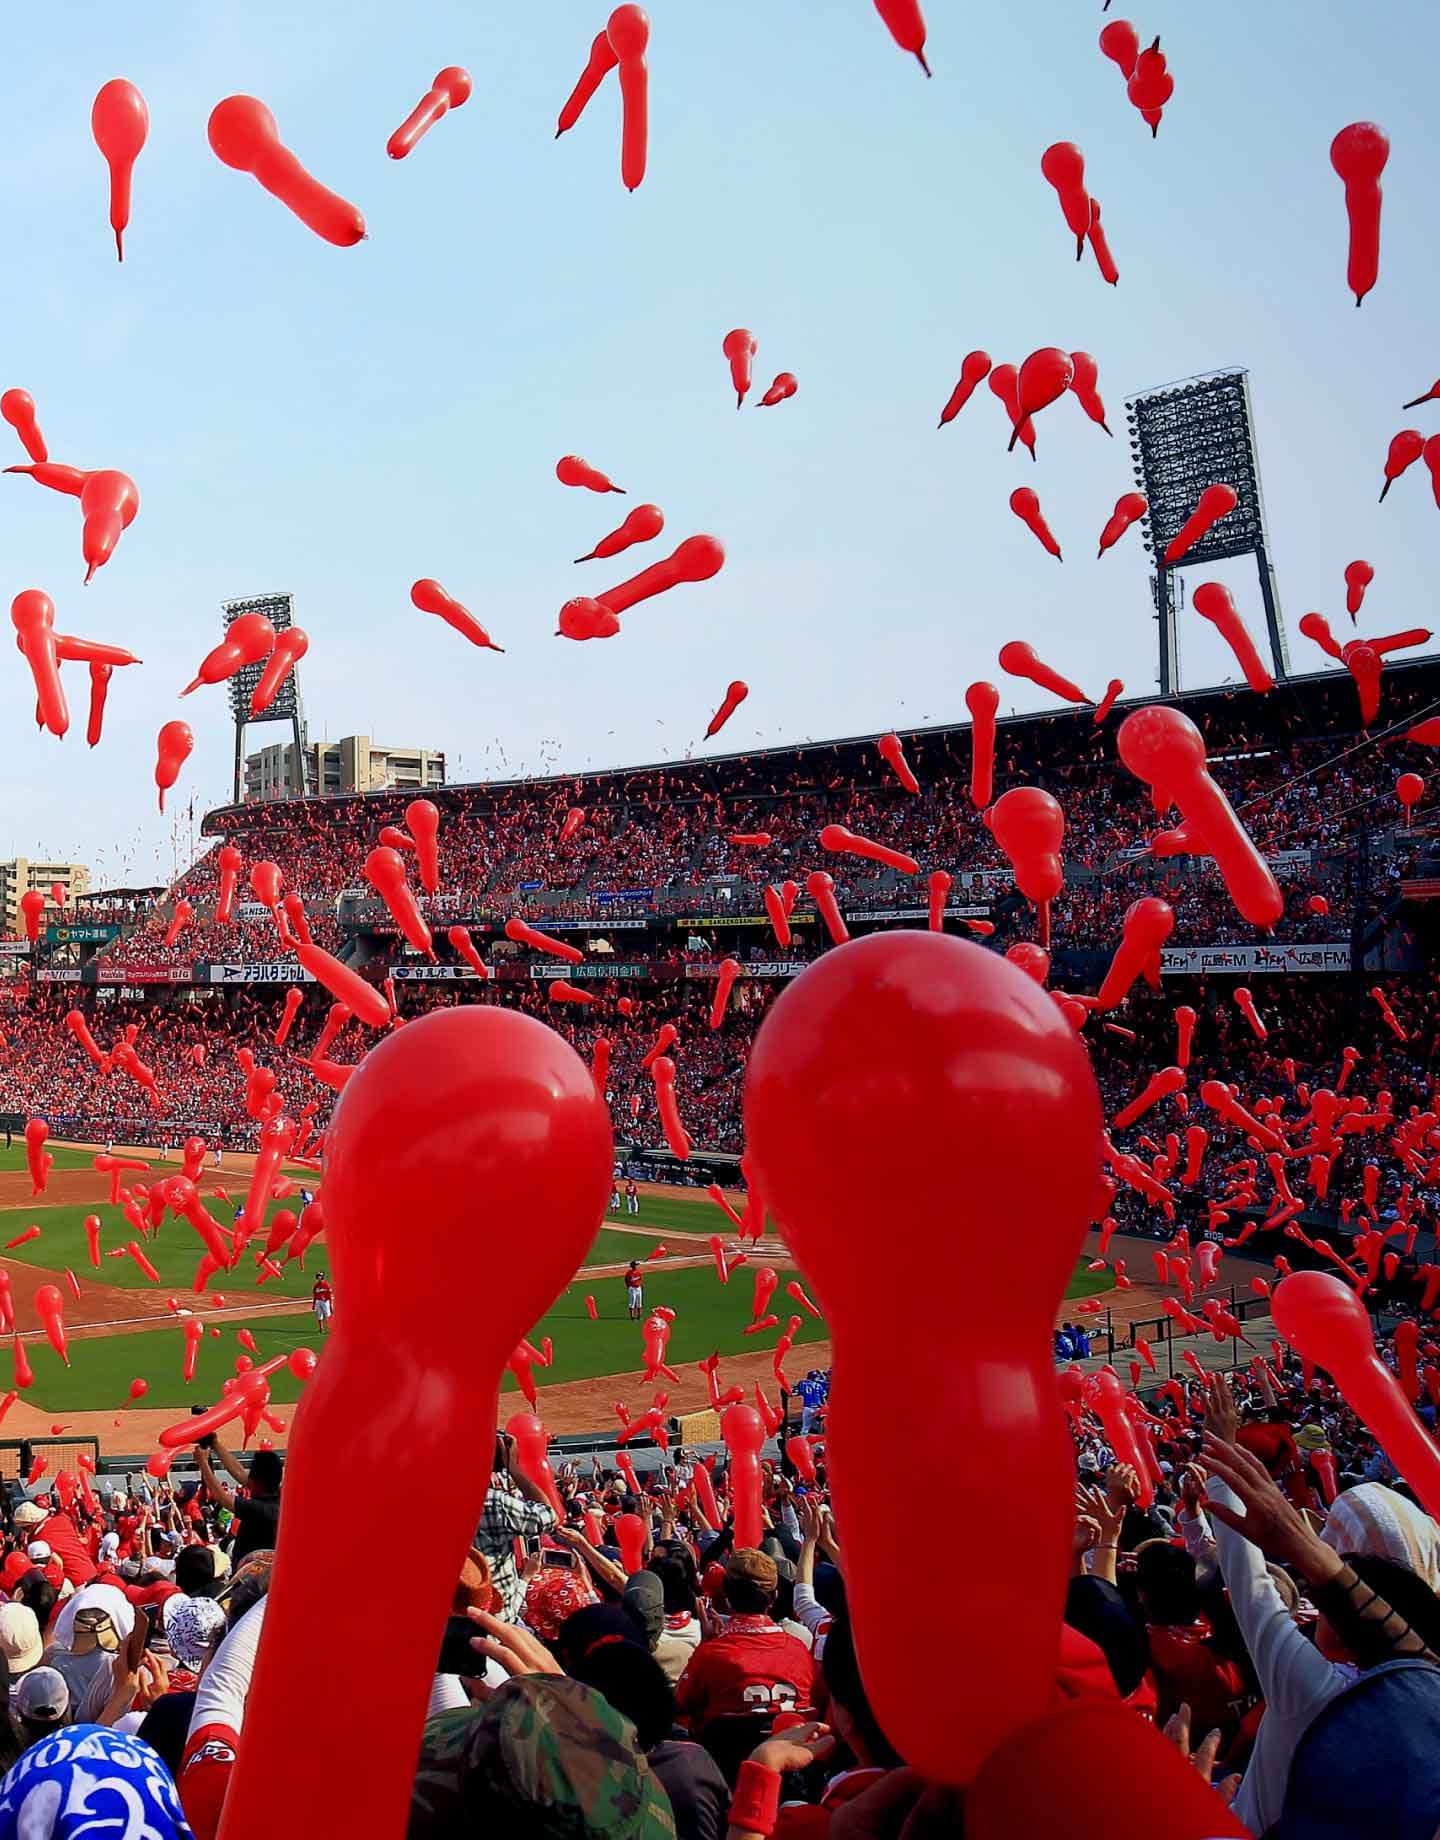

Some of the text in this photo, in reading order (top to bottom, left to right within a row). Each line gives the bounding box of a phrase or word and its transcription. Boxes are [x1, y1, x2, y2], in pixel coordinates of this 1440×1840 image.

[1201, 953, 1246, 966] 広島FM
[1298, 951, 1347, 965] 広島FM
[244, 966, 305, 980] アヲハタジャム
